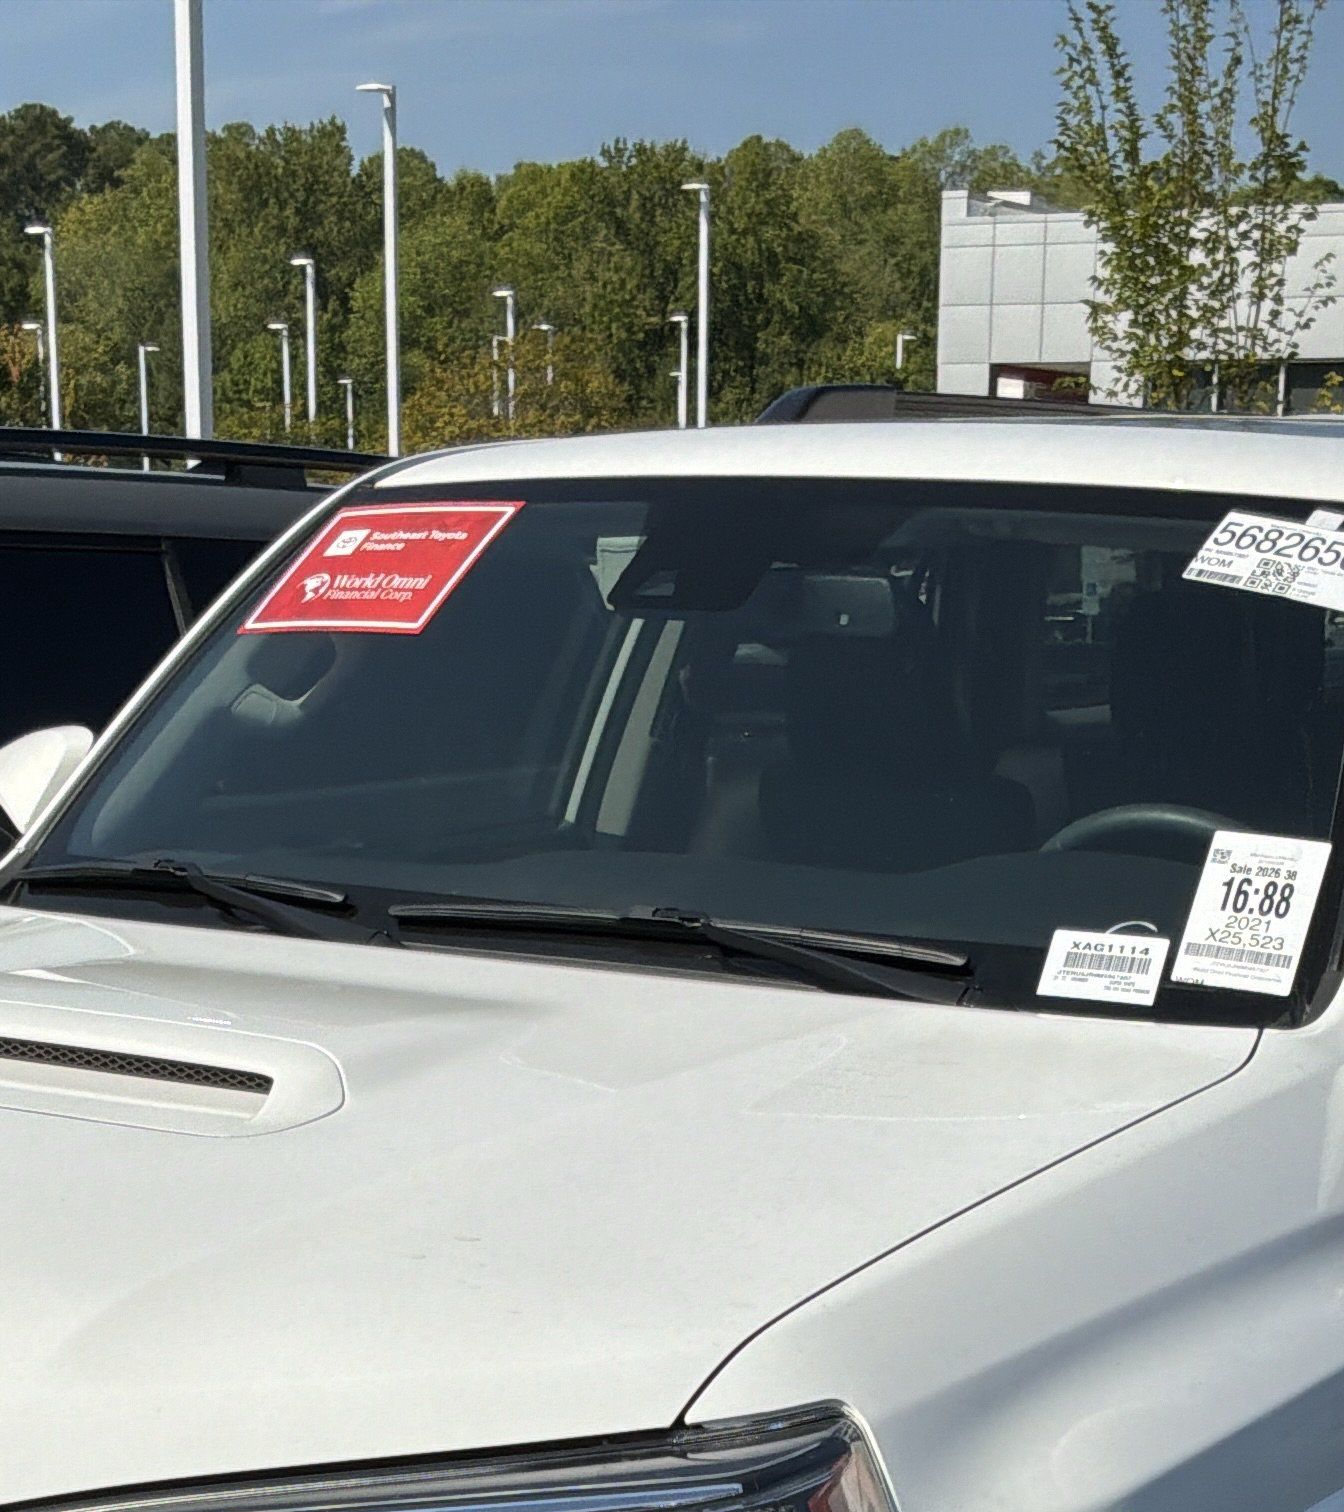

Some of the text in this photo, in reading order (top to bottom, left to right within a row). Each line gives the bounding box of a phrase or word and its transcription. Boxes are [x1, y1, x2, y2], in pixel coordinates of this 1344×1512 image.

[429, 529, 468, 542] Toyota
[359, 541, 405, 552] Finance
[333, 572, 431, 590] World Omni
[324, 589, 381, 601] Financial
[1229, 862, 1253, 876] Sale
[1254, 865, 1281, 879] 2026
[1220, 876, 1296, 920] 16:88
[1225, 915, 1272, 933] 2021
[1070, 941, 1151, 956] XAG1114
